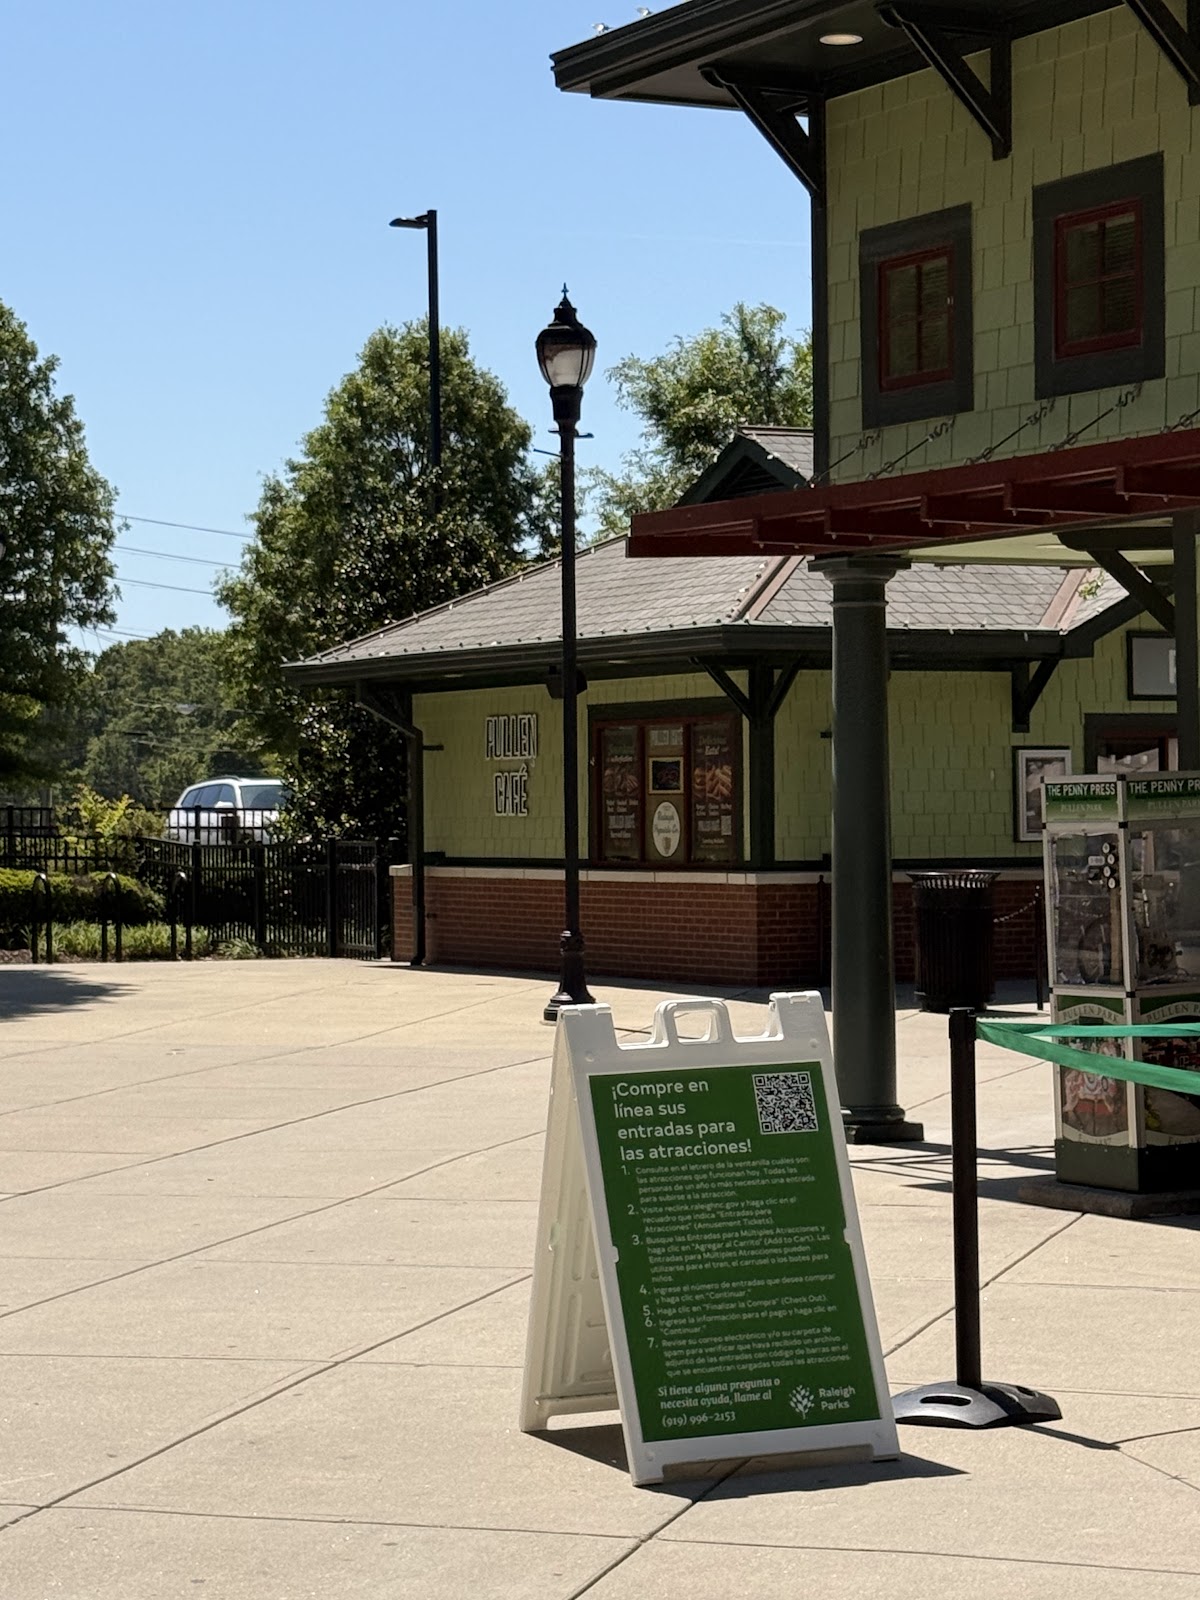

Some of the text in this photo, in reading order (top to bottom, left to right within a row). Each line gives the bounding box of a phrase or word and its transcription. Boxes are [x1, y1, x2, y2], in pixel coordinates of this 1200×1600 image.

[485, 713, 537, 763] PULLEN
[493, 763, 529, 817] CAFÉ
[1047, 783, 1115, 796] THE PENNY PRESS
[1129, 781, 1148, 795] THE
[1151, 780, 1184, 794] PENNY
[1062, 1005, 1095, 1021] PULLEN
[1146, 1003, 1189, 1022] PULLEN
[611, 1079, 709, 1100] ¡Compre en
[613, 1101, 686, 1118] línea sus
[616, 1120, 736, 1139] entradas para
[619, 1138, 751, 1160] las atracciones!
[620, 1165, 630, 1175] 1.
[627, 1203, 638, 1214] 2.
[631, 1233, 643, 1245] 3.
[638, 1283, 650, 1295] 4.
[642, 1304, 654, 1316] 5.
[644, 1316, 656, 1327] 6.
[647, 1337, 658, 1348] 7.
[657, 1386, 667, 1396] Si
[668, 1384, 693, 1395] tiene
[694, 1380, 728, 1395] alguna
[729, 1378, 772, 1391] pregunta
[818, 1385, 855, 1400] Raleigh
[659, 1389, 772, 1409] necesita ayuda, llame al
[820, 1398, 849, 1410] Parks
[661, 1410, 736, 1428] (919) 996-2153
